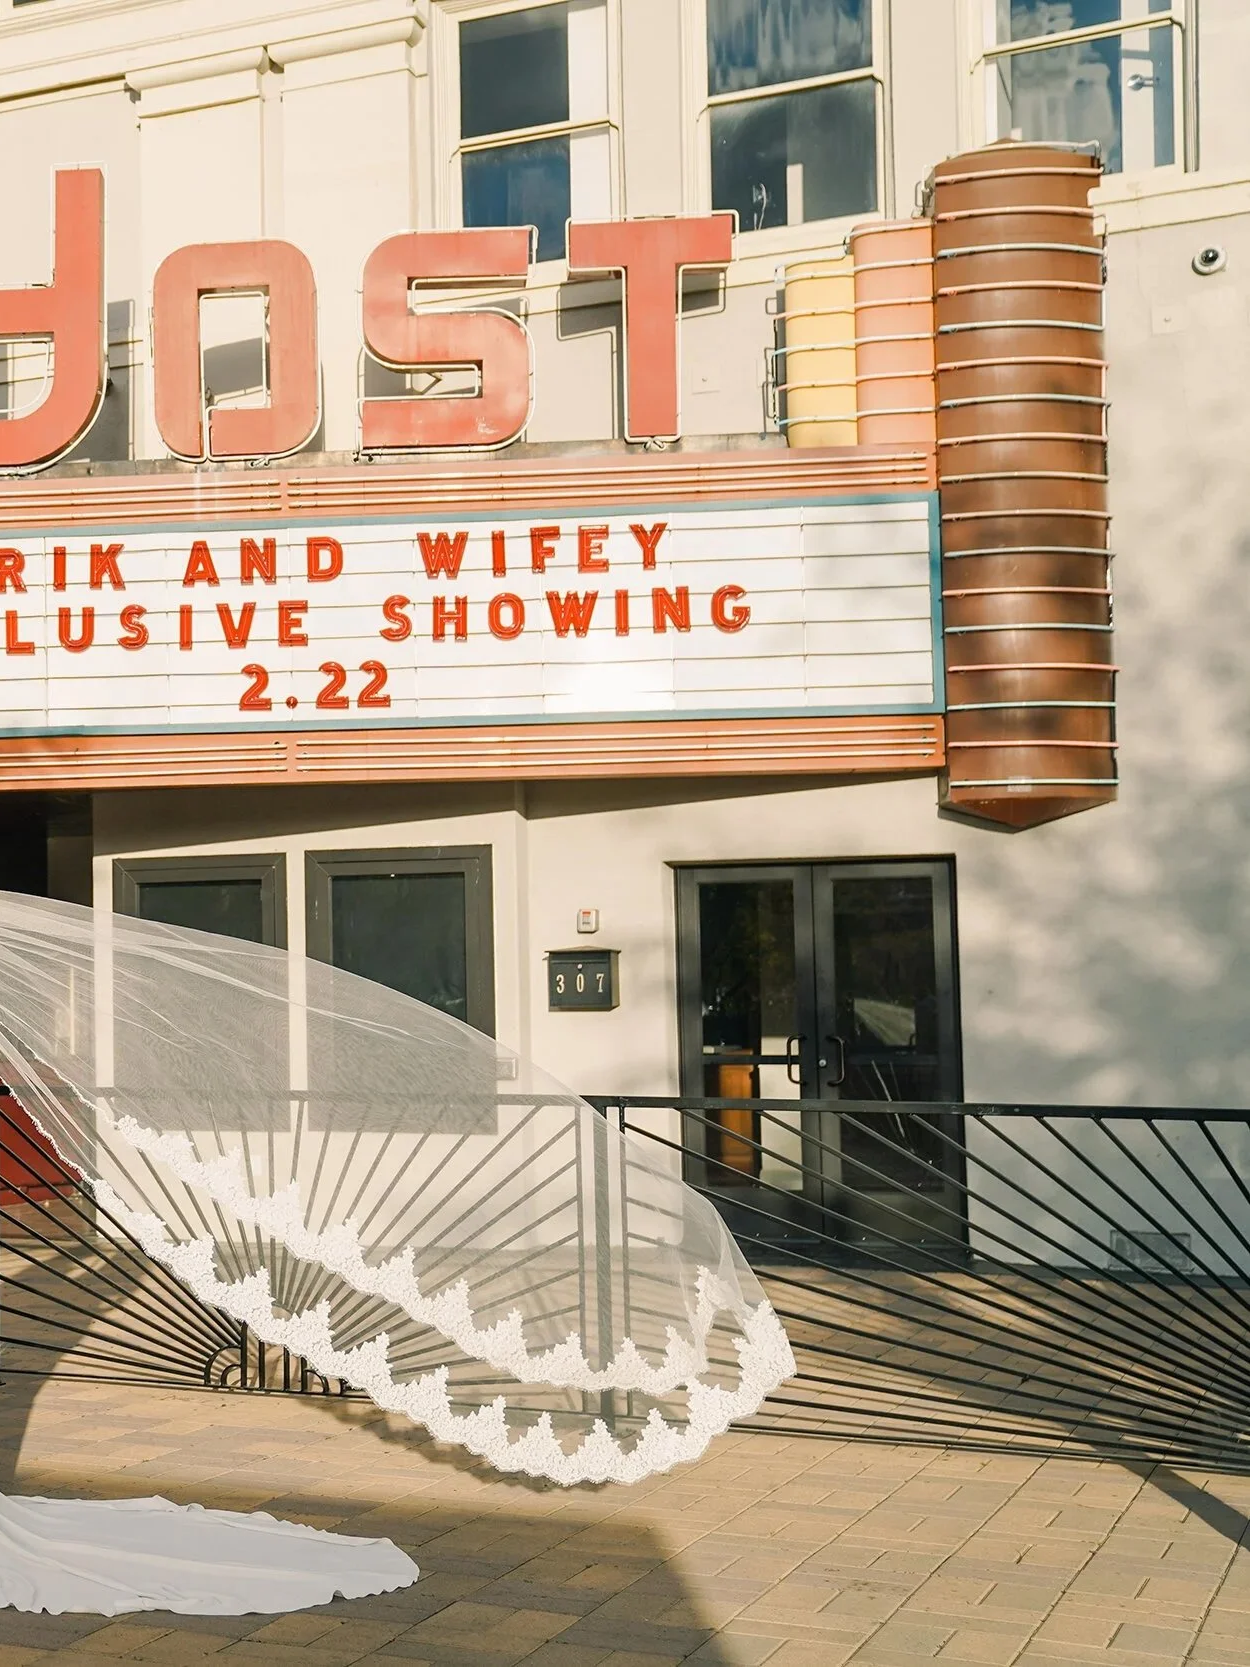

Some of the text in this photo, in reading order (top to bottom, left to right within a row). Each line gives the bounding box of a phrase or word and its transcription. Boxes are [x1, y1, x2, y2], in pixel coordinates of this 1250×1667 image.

[182, 537, 343, 587] AND
[415, 522, 668, 580] WIFEY
[379, 584, 751, 642] SHOWING
[239, 659, 391, 711] 2.22
[556, 973, 605, 993] 307
